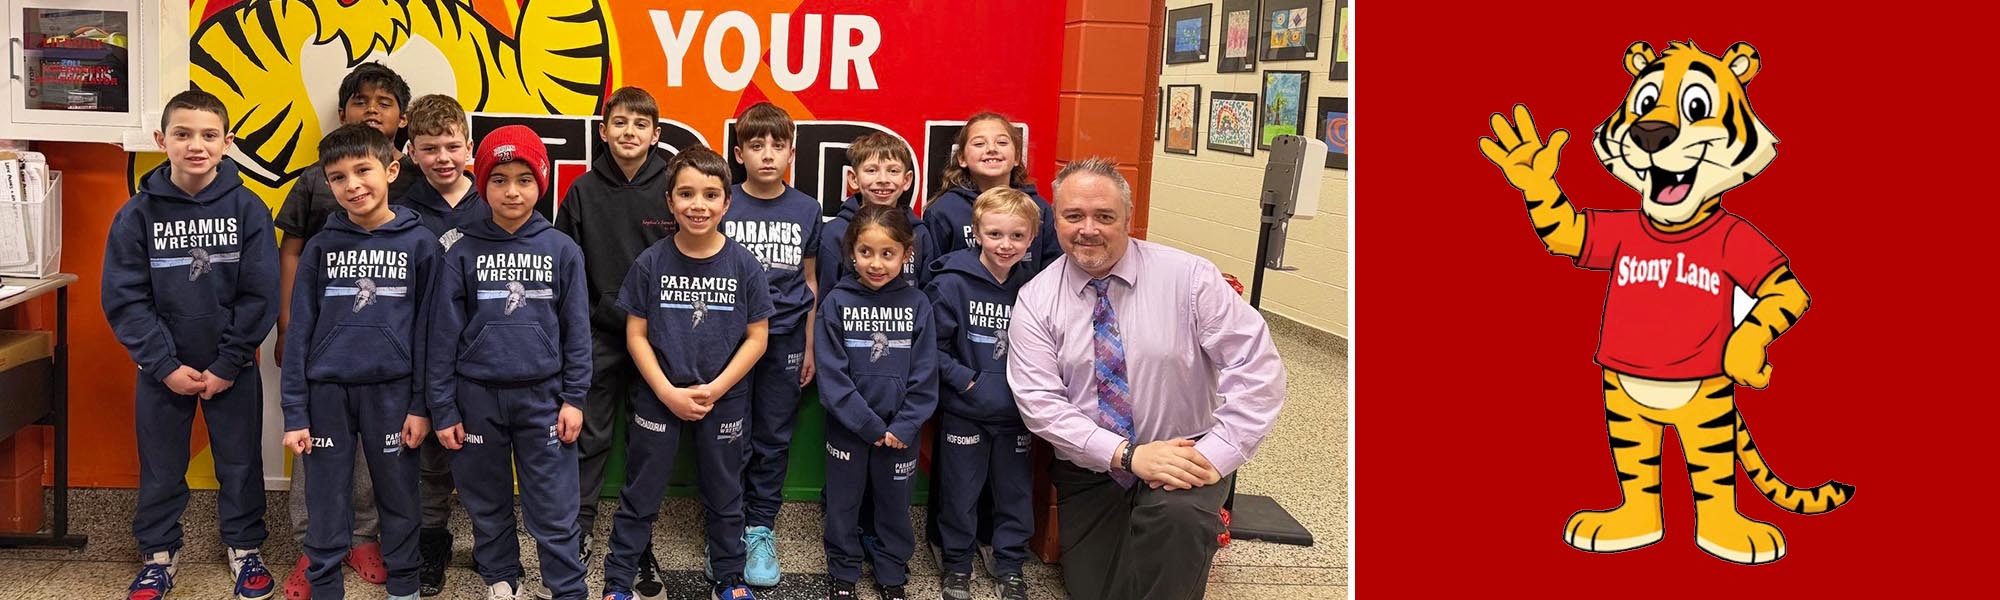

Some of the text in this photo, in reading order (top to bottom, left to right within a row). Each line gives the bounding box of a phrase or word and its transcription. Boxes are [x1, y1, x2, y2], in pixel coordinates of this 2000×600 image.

[649, 10, 882, 91] YOUR
[153, 217, 237, 237] PARAMUS
[725, 220, 802, 245] PARAMUS
[154, 233, 238, 250] WRESTLING
[327, 249, 408, 267] PARAMUS
[476, 253, 553, 270] PARAMUS
[327, 265, 407, 279] WRESTLING
[476, 268, 553, 282] WRESTLING
[1617, 252, 1720, 295] Stony Lane
[660, 275, 738, 292] PARAMUS
[660, 290, 736, 304] WRESTLING
[843, 306, 914, 320] PARAMUS
[969, 300, 1013, 319] PARAM
[843, 320, 914, 332] WRESTLING
[969, 314, 1009, 330] WREST
[310, 436, 334, 448] ZZIA
[464, 432, 484, 445] HINI
